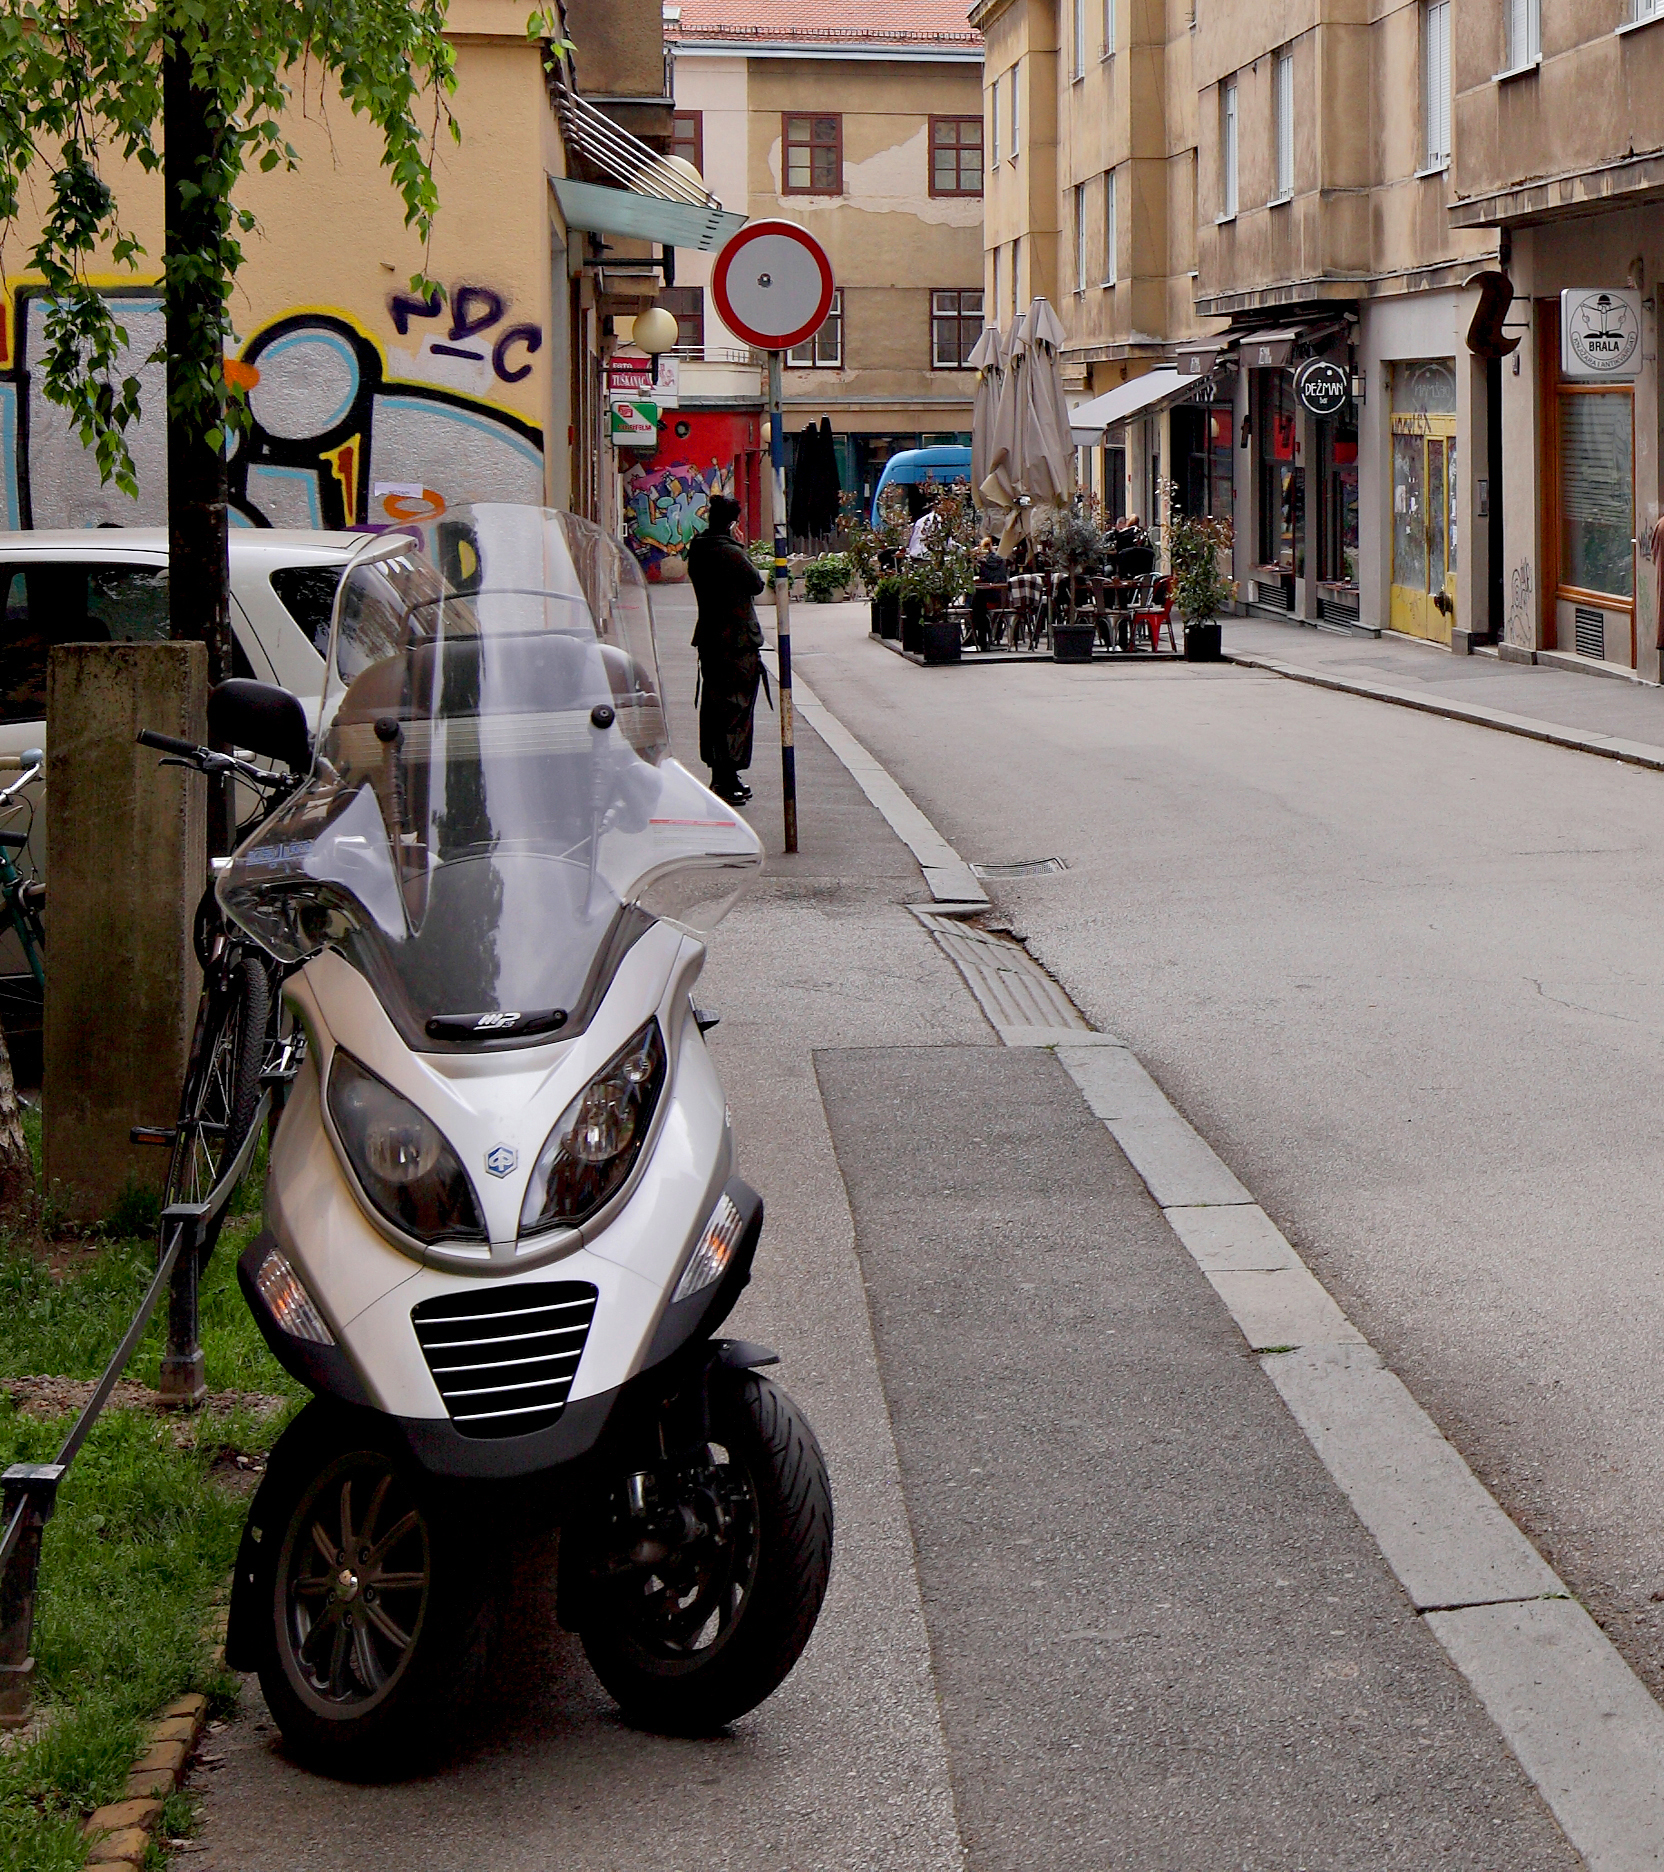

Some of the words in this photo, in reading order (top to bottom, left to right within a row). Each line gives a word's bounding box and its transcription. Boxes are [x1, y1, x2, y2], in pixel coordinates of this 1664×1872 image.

[1588, 341, 1620, 352] BRALA
[1305, 379, 1344, 397] DEŽMAN
[1319, 396, 1328, 404] bar
